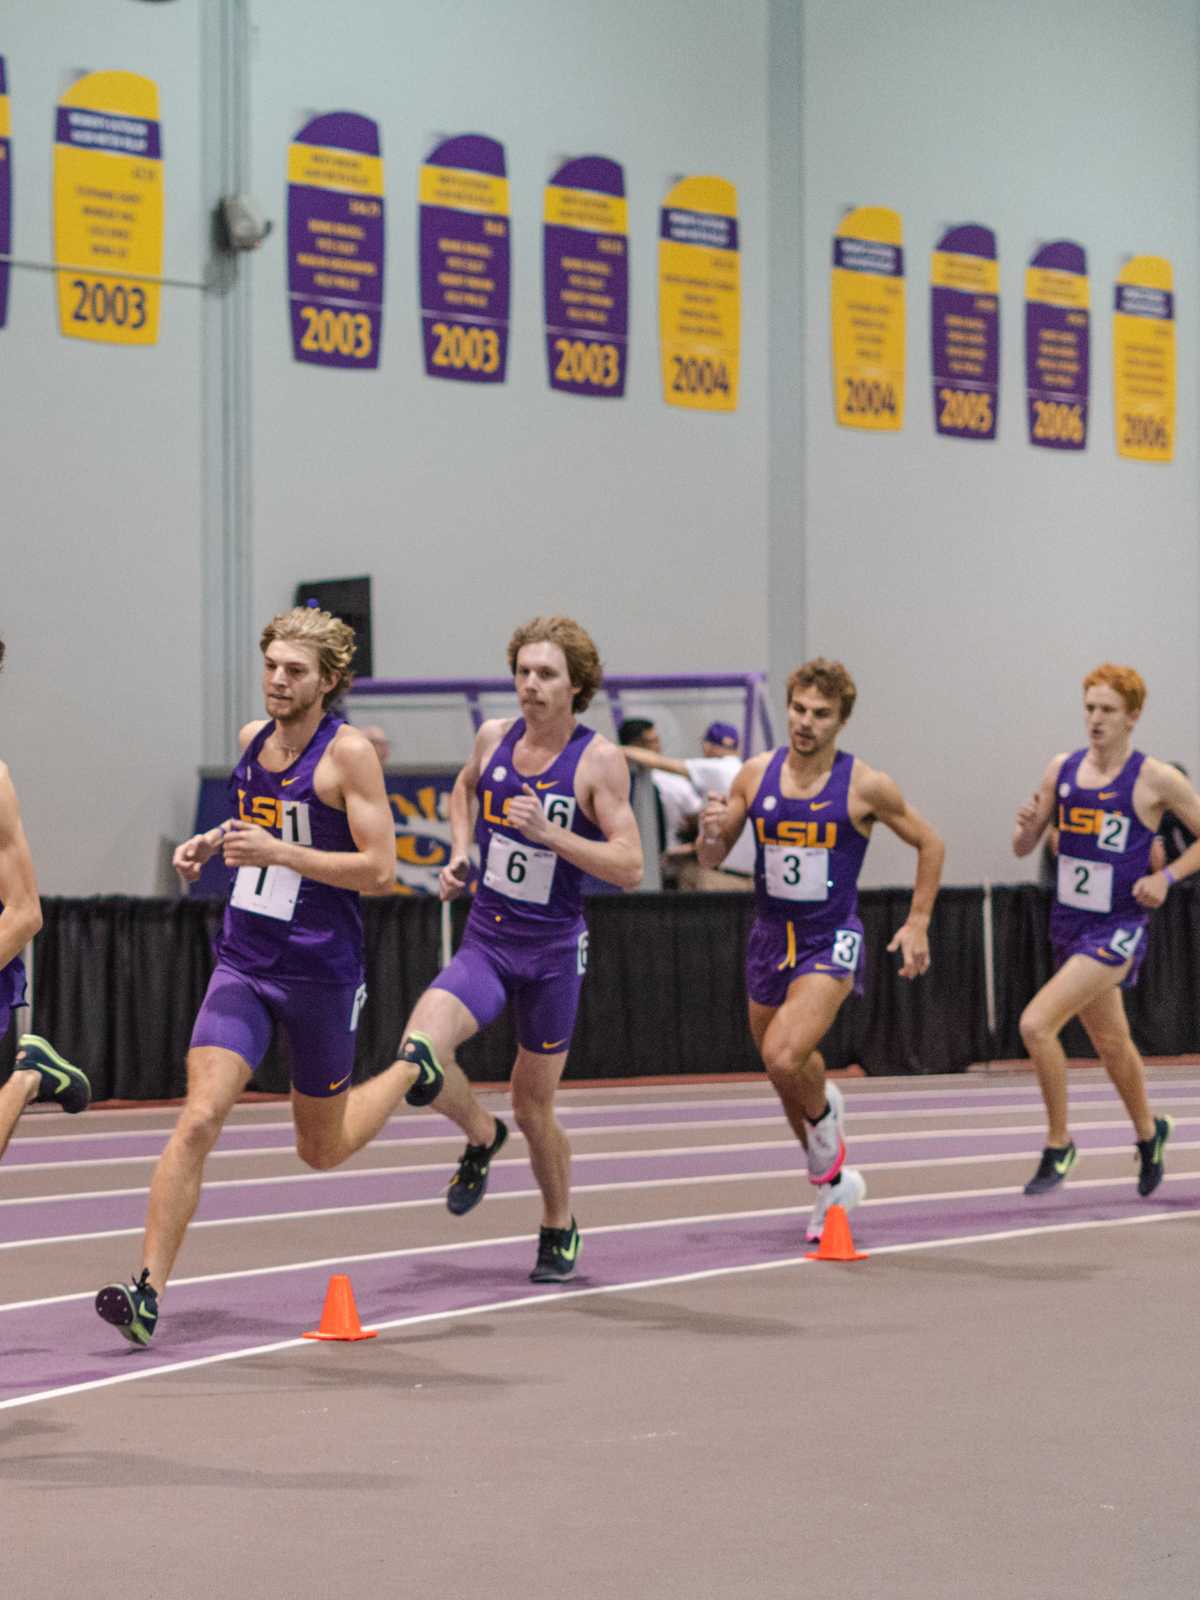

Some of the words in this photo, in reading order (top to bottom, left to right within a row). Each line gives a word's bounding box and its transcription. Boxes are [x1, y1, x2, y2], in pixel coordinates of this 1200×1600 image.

[71, 279, 147, 330] 2003
[301, 306, 372, 358] 2003
[431, 323, 500, 373] 2003
[554, 339, 620, 387] 2003
[671, 355, 731, 397] 2004
[844, 377, 897, 416] 2004
[285, 805, 300, 842] 1
[548, 800, 569, 828] 6
[756, 818, 838, 849] LSU
[1103, 818, 1123, 848] 2
[507, 851, 528, 883] 6
[783, 855, 801, 886] 3
[1074, 866, 1090, 895] 2
[838, 934, 857, 963] 3
